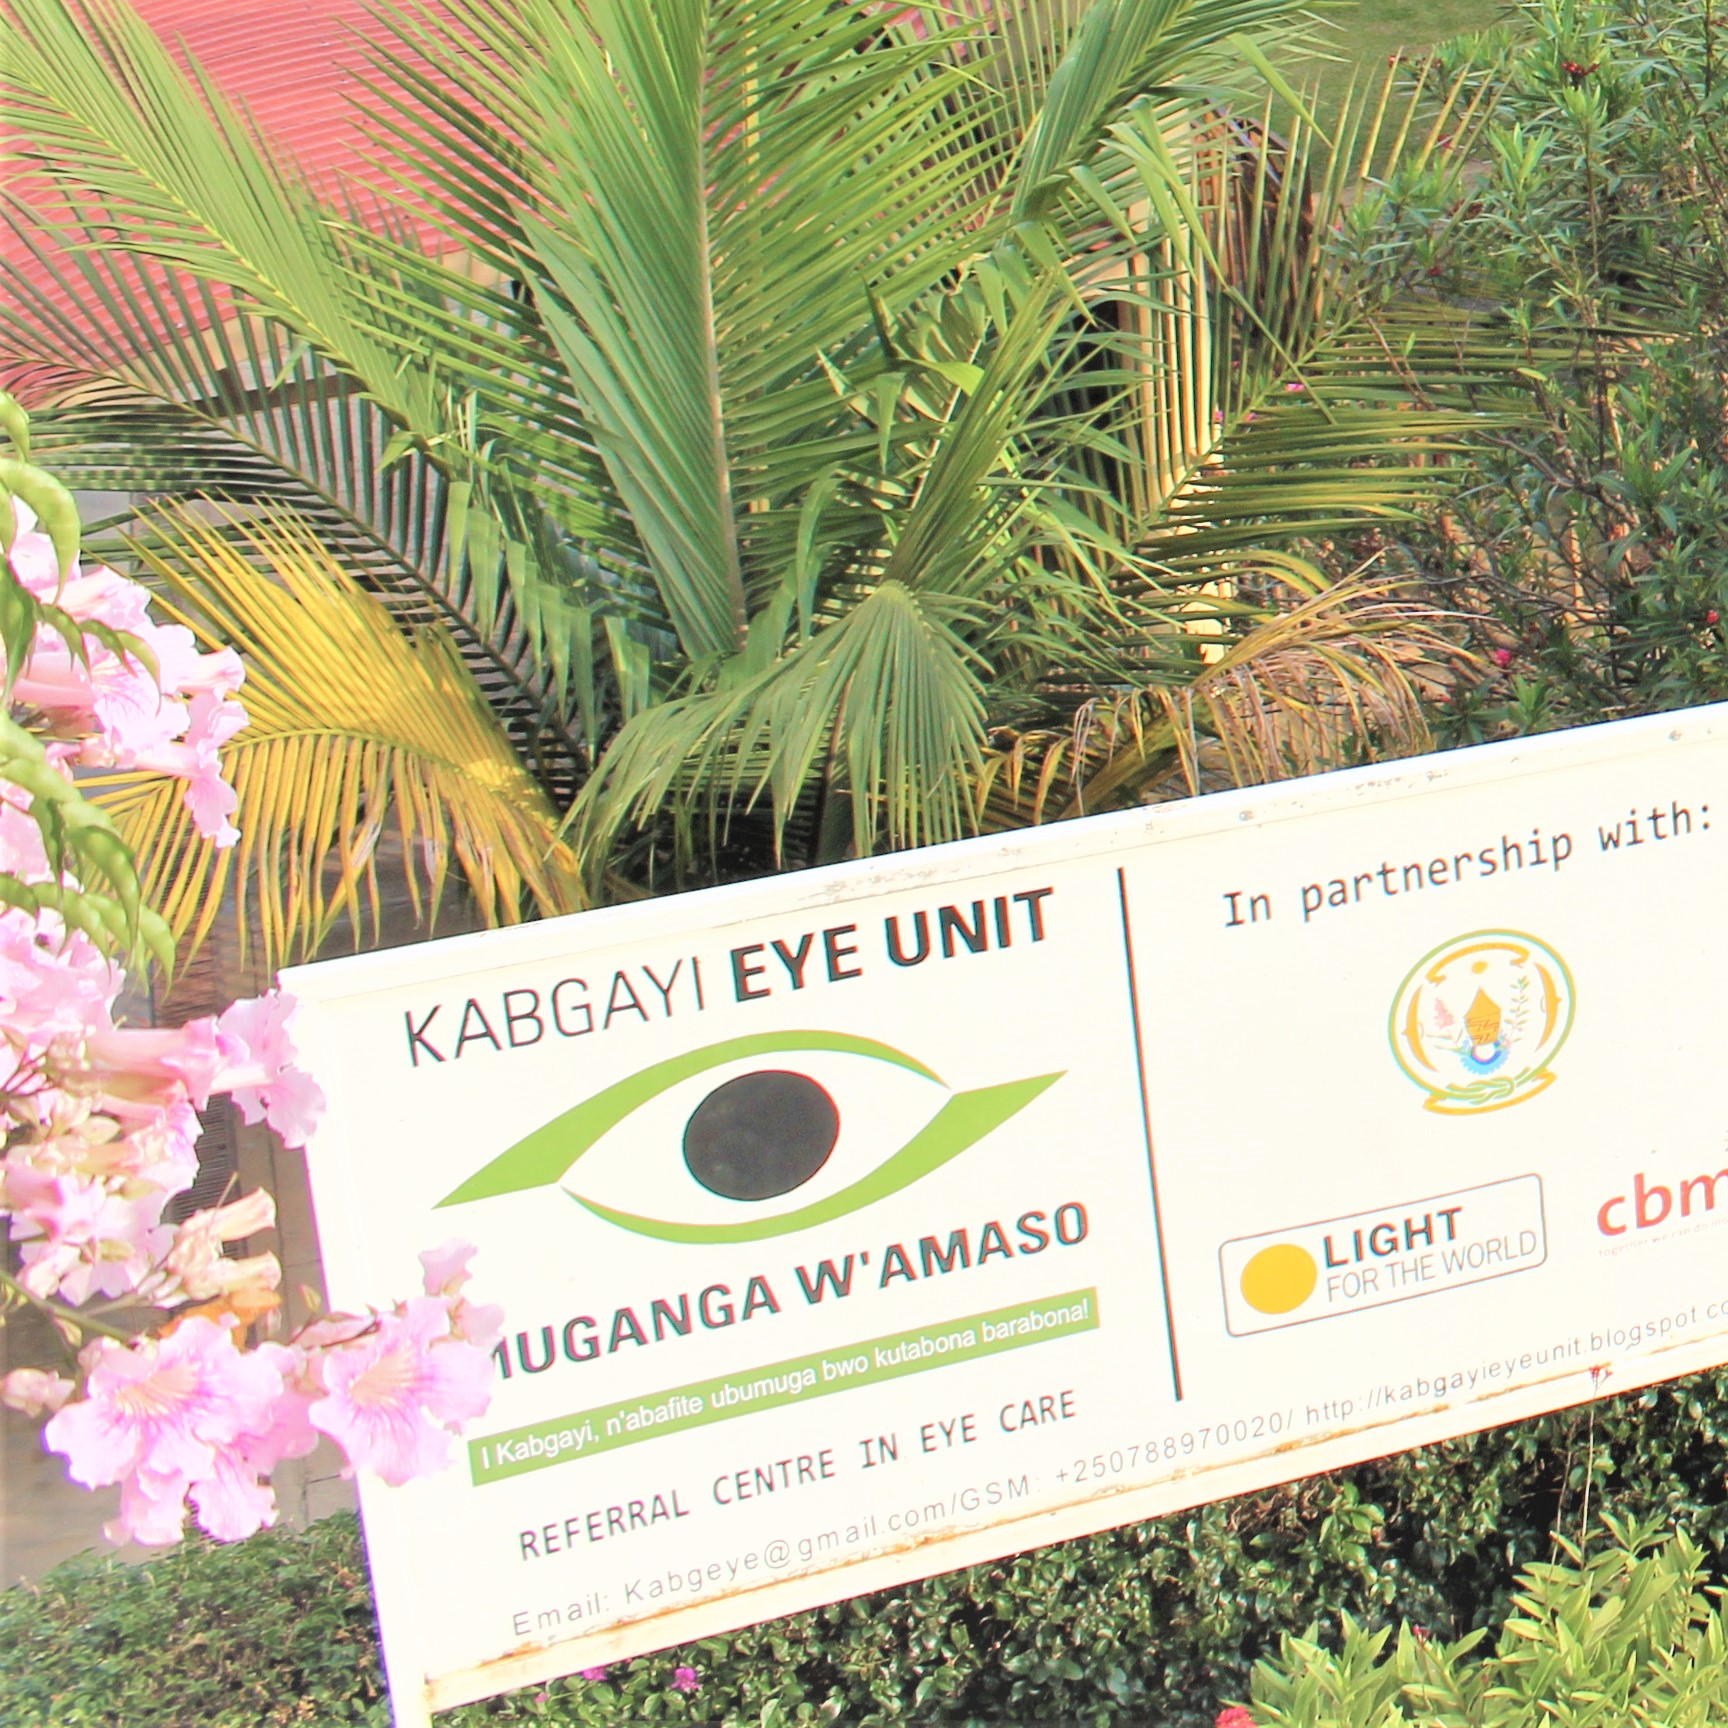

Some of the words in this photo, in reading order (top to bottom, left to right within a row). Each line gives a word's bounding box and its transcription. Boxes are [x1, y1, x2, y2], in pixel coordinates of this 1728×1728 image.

[1223, 890, 1273, 928] In
[1300, 828, 1573, 923] partnership
[1599, 800, 1712, 852] with:
[404, 955, 705, 1067] KABGAYI
[730, 924, 863, 1002] EYE
[884, 886, 1055, 968] UNIT
[794, 1201, 1090, 1305] W'AMASO
[1323, 1205, 1463, 1269] LIGHT
[1326, 1267, 1380, 1303] FOR
[1386, 1254, 1436, 1289] THE
[1441, 1229, 1539, 1275] WORLD
[497, 1420, 600, 1466] Kabgayi,
[606, 1393, 704, 1435] n'abafite
[710, 1367, 816, 1409] ubumuga
[822, 1353, 869, 1381] bwo
[875, 1329, 976, 1368] kutabona
[982, 1297, 1091, 1343] barabona!
[519, 1489, 690, 1561] REFERRAL
[713, 1449, 836, 1505] CENTRE
[859, 1432, 899, 1469] IN
[920, 1413, 978, 1453] EYE
[999, 1390, 1077, 1433] CARE
[512, 1592, 610, 1637] Email:
